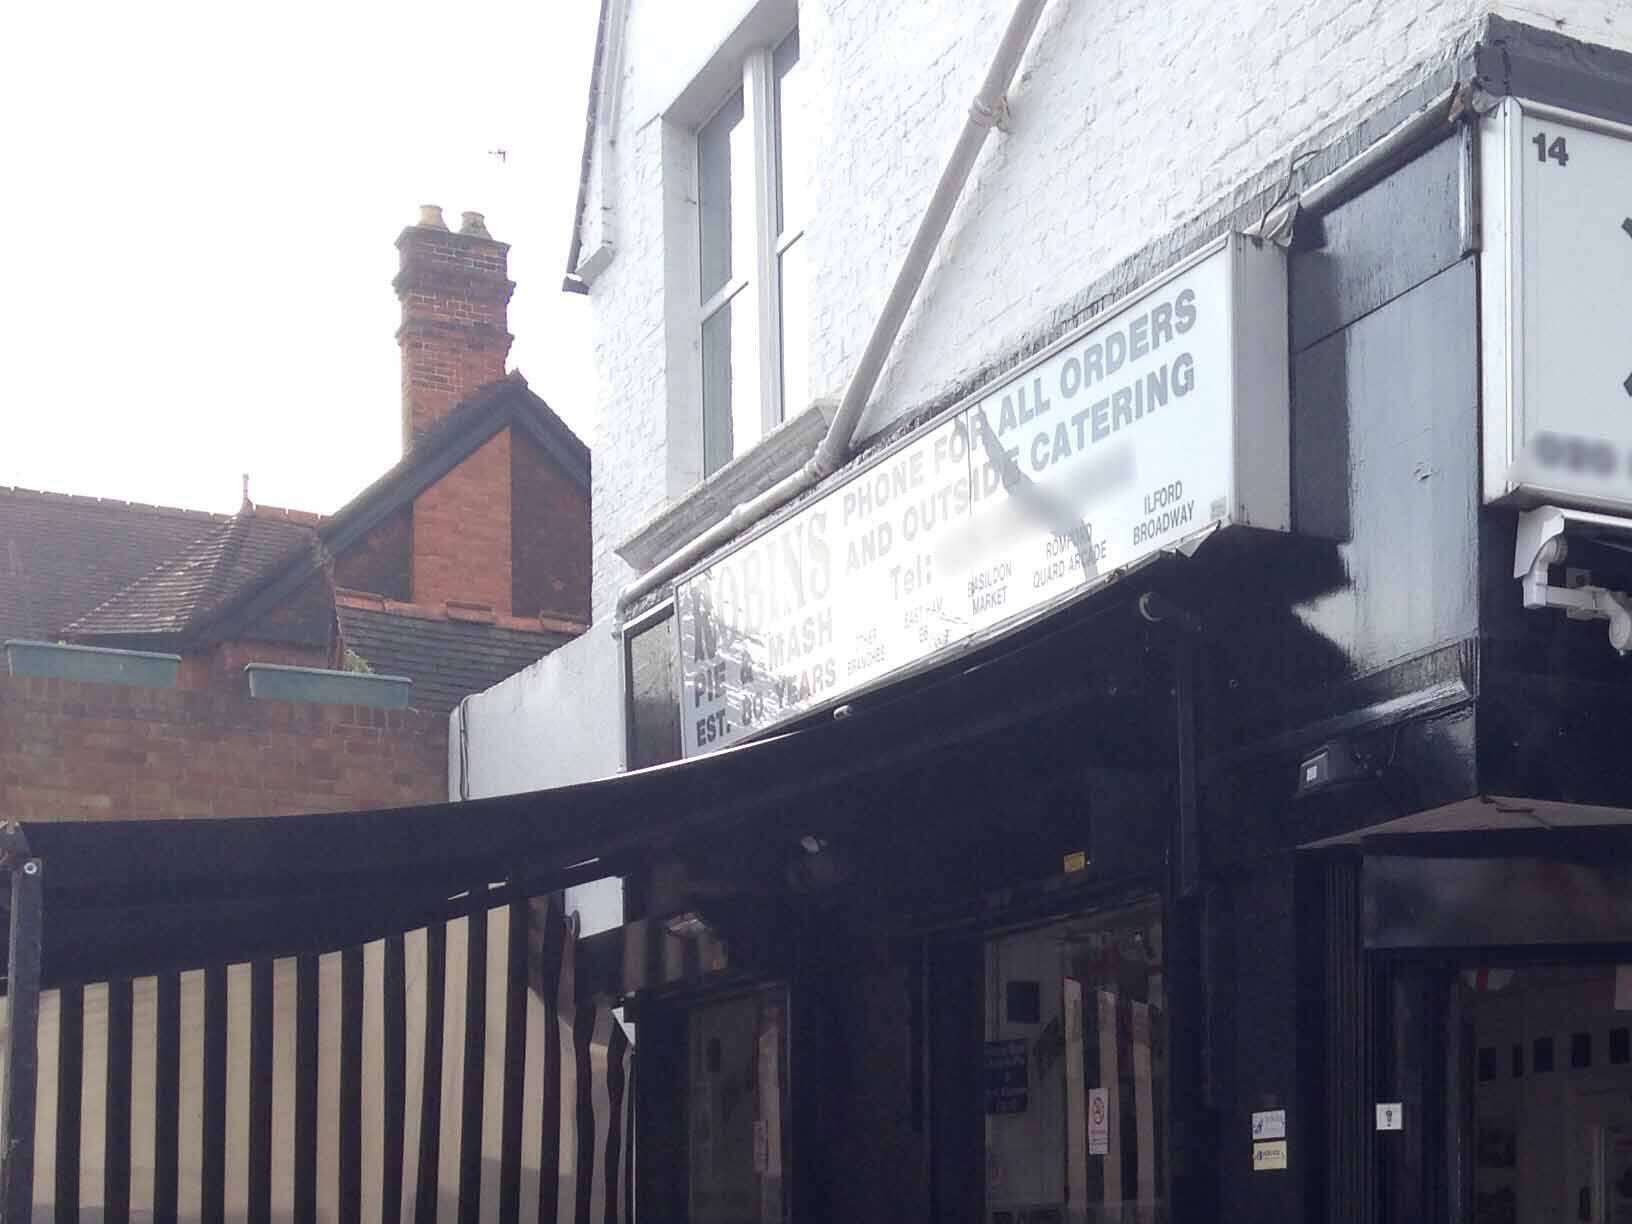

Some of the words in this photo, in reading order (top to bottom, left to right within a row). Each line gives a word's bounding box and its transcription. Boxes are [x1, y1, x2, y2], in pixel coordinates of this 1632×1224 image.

[1532, 132, 1569, 167] 14
[842, 452, 924, 526] PHONE
[934, 412, 988, 473] FOR
[998, 376, 1050, 434] ALL
[1060, 288, 1197, 398] ORDERS
[846, 521, 892, 576] AND
[902, 446, 1020, 542] OUTSIDE
[1031, 352, 1195, 473] CATERING
[1144, 480, 1183, 516] ILFORD
[1133, 500, 1195, 546] BROADWAY
[690, 512, 833, 662] ROBINS
[968, 560, 1012, 598] BASILDON
[973, 586, 1007, 616] MARKET
[693, 662, 726, 708] PIE
[766, 608, 833, 672] MASH
[696, 709, 731, 747] EST.
[775, 657, 837, 708] YEARS
